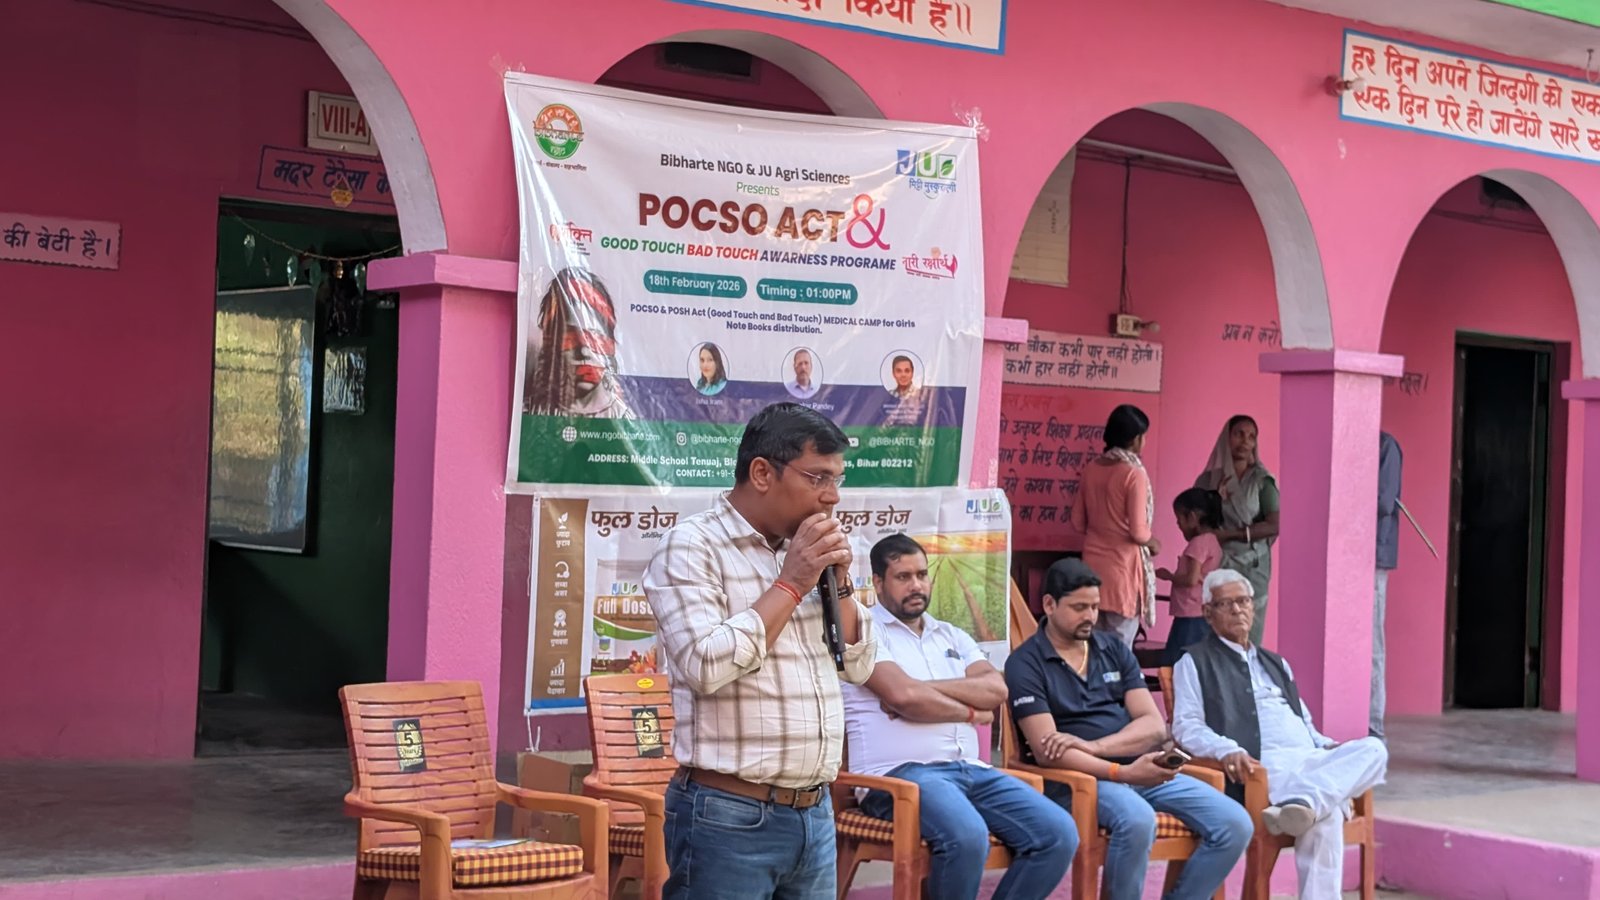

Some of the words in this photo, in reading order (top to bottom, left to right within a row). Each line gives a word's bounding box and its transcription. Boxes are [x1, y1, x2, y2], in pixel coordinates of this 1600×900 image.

[1352, 45, 1376, 77] हर
[1384, 44, 1420, 84] दिन
[1425, 59, 1472, 92] अपने
[1542, 78, 1563, 109] को
[322, 103, 367, 137] VIII-A
[1397, 83, 1430, 124] दिन
[1434, 95, 1463, 131] पूरे
[1467, 99, 1484, 134] हो
[1549, 117, 1581, 152] सारे
[273, 159, 315, 189] मदर
[660, 153, 715, 171] Bibharte
[717, 160, 743, 174] NGO
[746, 163, 756, 175] &
[758, 165, 772, 177] JU
[775, 166, 799, 182] Agri
[802, 169, 850, 185] Sciences
[736, 182, 780, 196] Presents
[638, 192, 769, 236] POCSO
[774, 206, 845, 242] ACT
[846, 193, 891, 251] &
[3, 222, 31, 248] की
[36, 226, 76, 253] बेटी
[601, 236, 639, 250] GOOD
[641, 240, 685, 255] TOUCH
[686, 244, 714, 257] BAD
[716, 246, 758, 261] TOUCH
[760, 250, 828, 266] AWARNESS
[830, 254, 897, 271] PROGRAME
[648, 274, 670, 286] 18th
[671, 276, 715, 292] February
[717, 280, 740, 291] 2026
[760, 284, 797, 299] Timing
[806, 286, 852, 300] 01:00PM
[630, 303, 659, 314] POCSO
[660, 305, 667, 314] &
[668, 306, 690, 316] POSH
[691, 308, 706, 316] Act
[708, 307, 732, 319] (Good
[734, 310, 758, 320] Touch
[759, 313, 775, 321] and
[777, 313, 793, 322] Bad
[794, 314, 822, 325] Touch)
[824, 316, 857, 326] MEDICAL
[859, 318, 882, 327] CAMP
[883, 319, 894, 328] for
[896, 319, 916, 329] Girls
[726, 321, 747, 330] Note
[748, 322, 771, 332] Books
[773, 323, 823, 335] distribution.
[1059, 336, 1084, 358] कभी
[1005, 355, 1032, 374] कभी
[1035, 361, 1055, 378] हार
[588, 453, 629, 463] ADDRESS:
[631, 455, 658, 464] Middle
[660, 455, 688, 465] School
[691, 456, 722, 468] Tenuaj,
[856, 458, 879, 468] Bihar
[881, 458, 913, 468] 802212
[675, 468, 715, 478] CONTACT:
[591, 511, 635, 537] फुल
[836, 511, 874, 534] फुल
[597, 598, 617, 615] Full
[643, 718, 652, 733] 5
[404, 731, 414, 748] 5
